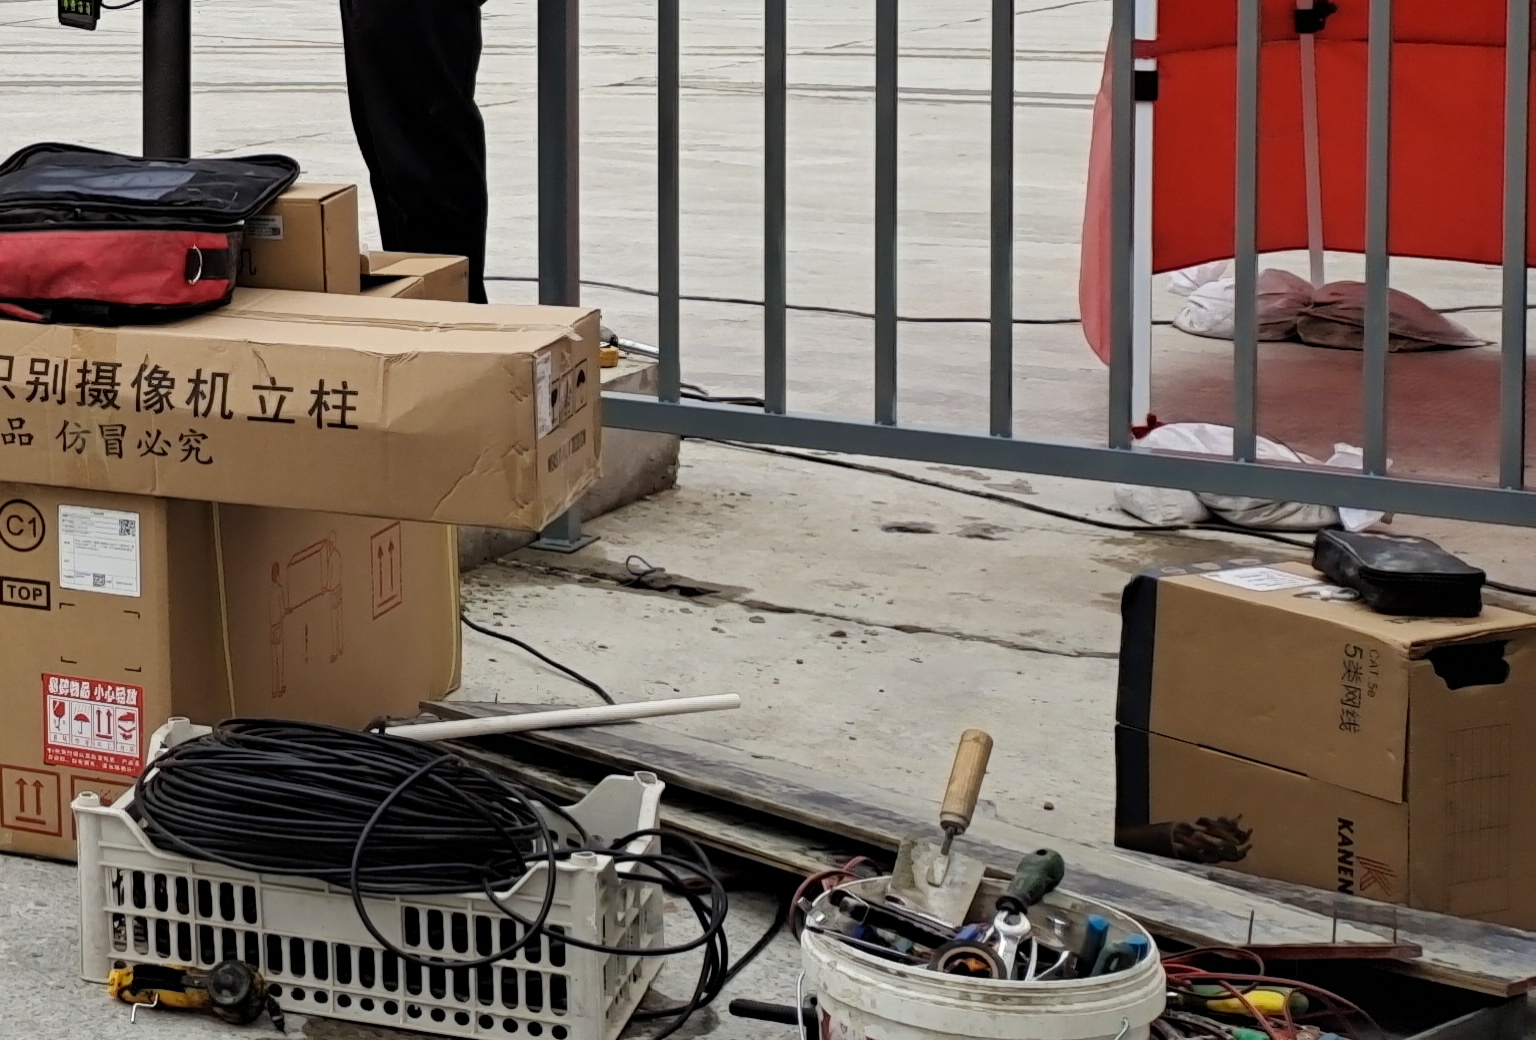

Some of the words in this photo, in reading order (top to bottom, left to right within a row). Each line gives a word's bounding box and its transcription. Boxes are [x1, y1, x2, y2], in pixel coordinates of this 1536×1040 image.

[55, 417, 214, 466] 仿冒必究
[6, 514, 38, 538] C1
[6, 584, 44, 602] TOP
[1338, 643, 1364, 734] 5类网线
